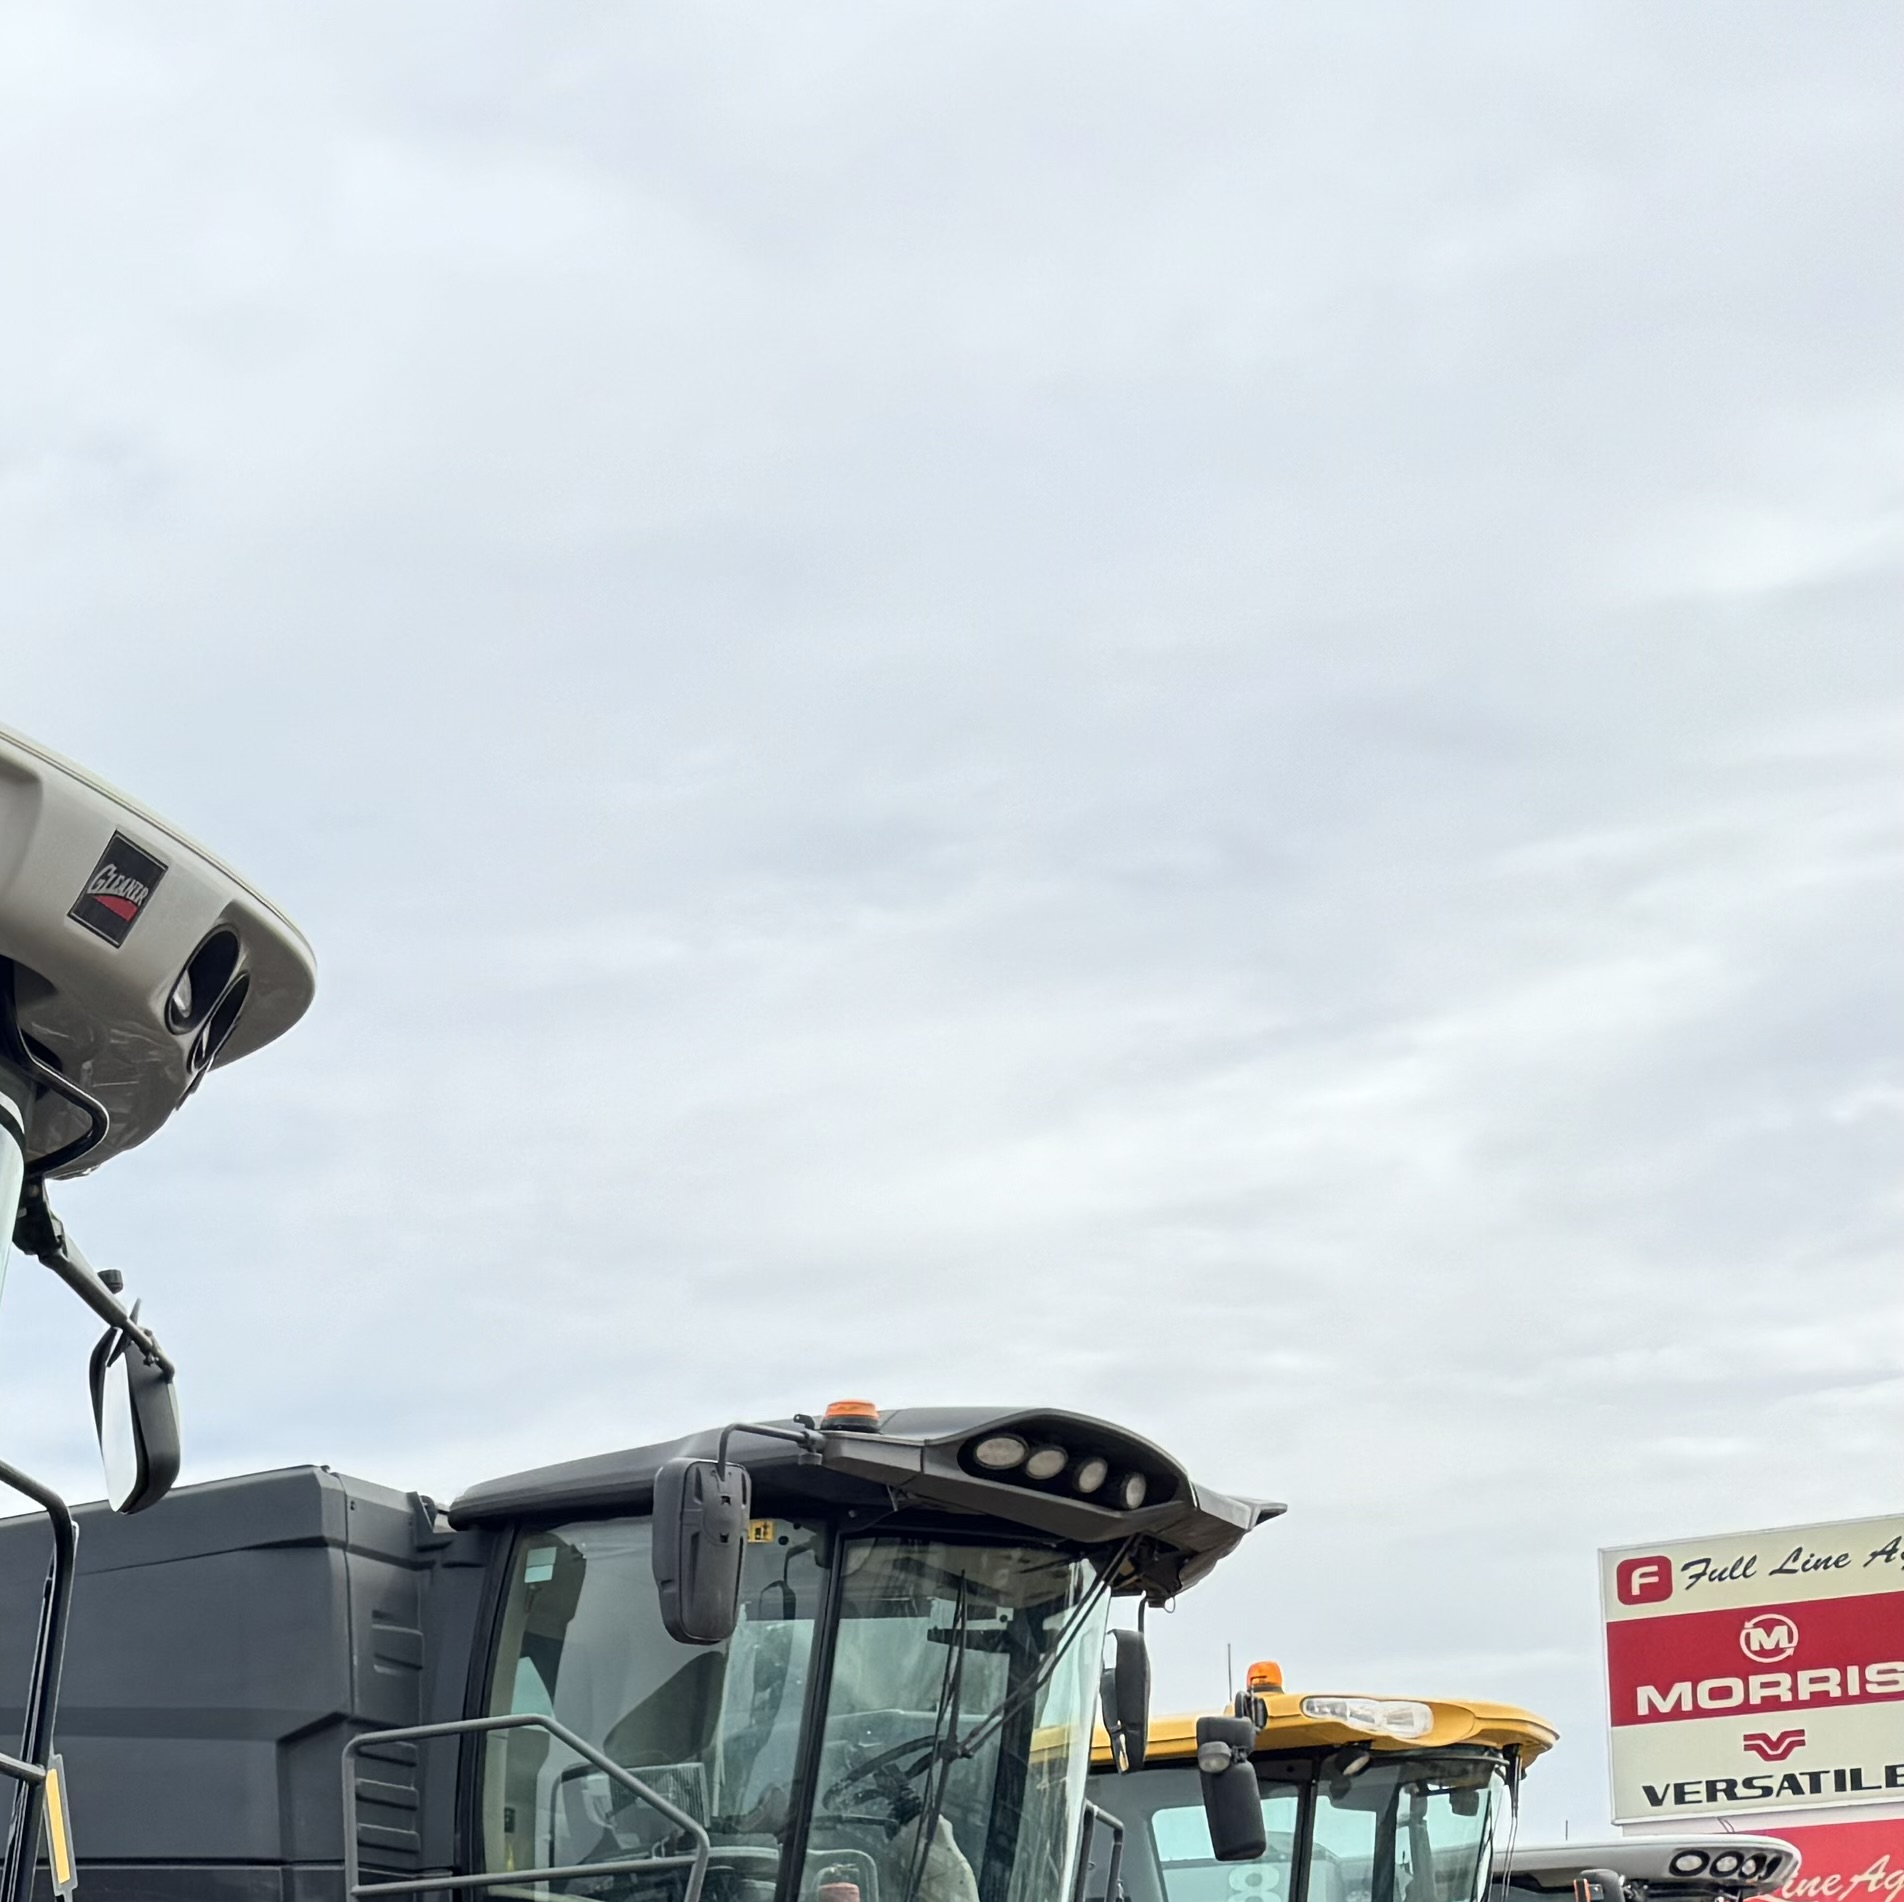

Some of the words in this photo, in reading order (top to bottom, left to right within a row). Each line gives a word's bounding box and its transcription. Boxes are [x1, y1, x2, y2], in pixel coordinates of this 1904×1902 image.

[1680, 1554, 1757, 1591] Full
[1768, 1546, 1852, 1576] Line
[1862, 1535, 1904, 1572] A
[1636, 1661, 1904, 1716] MORRIS
[1642, 1764, 1904, 1807] VERSATILE
